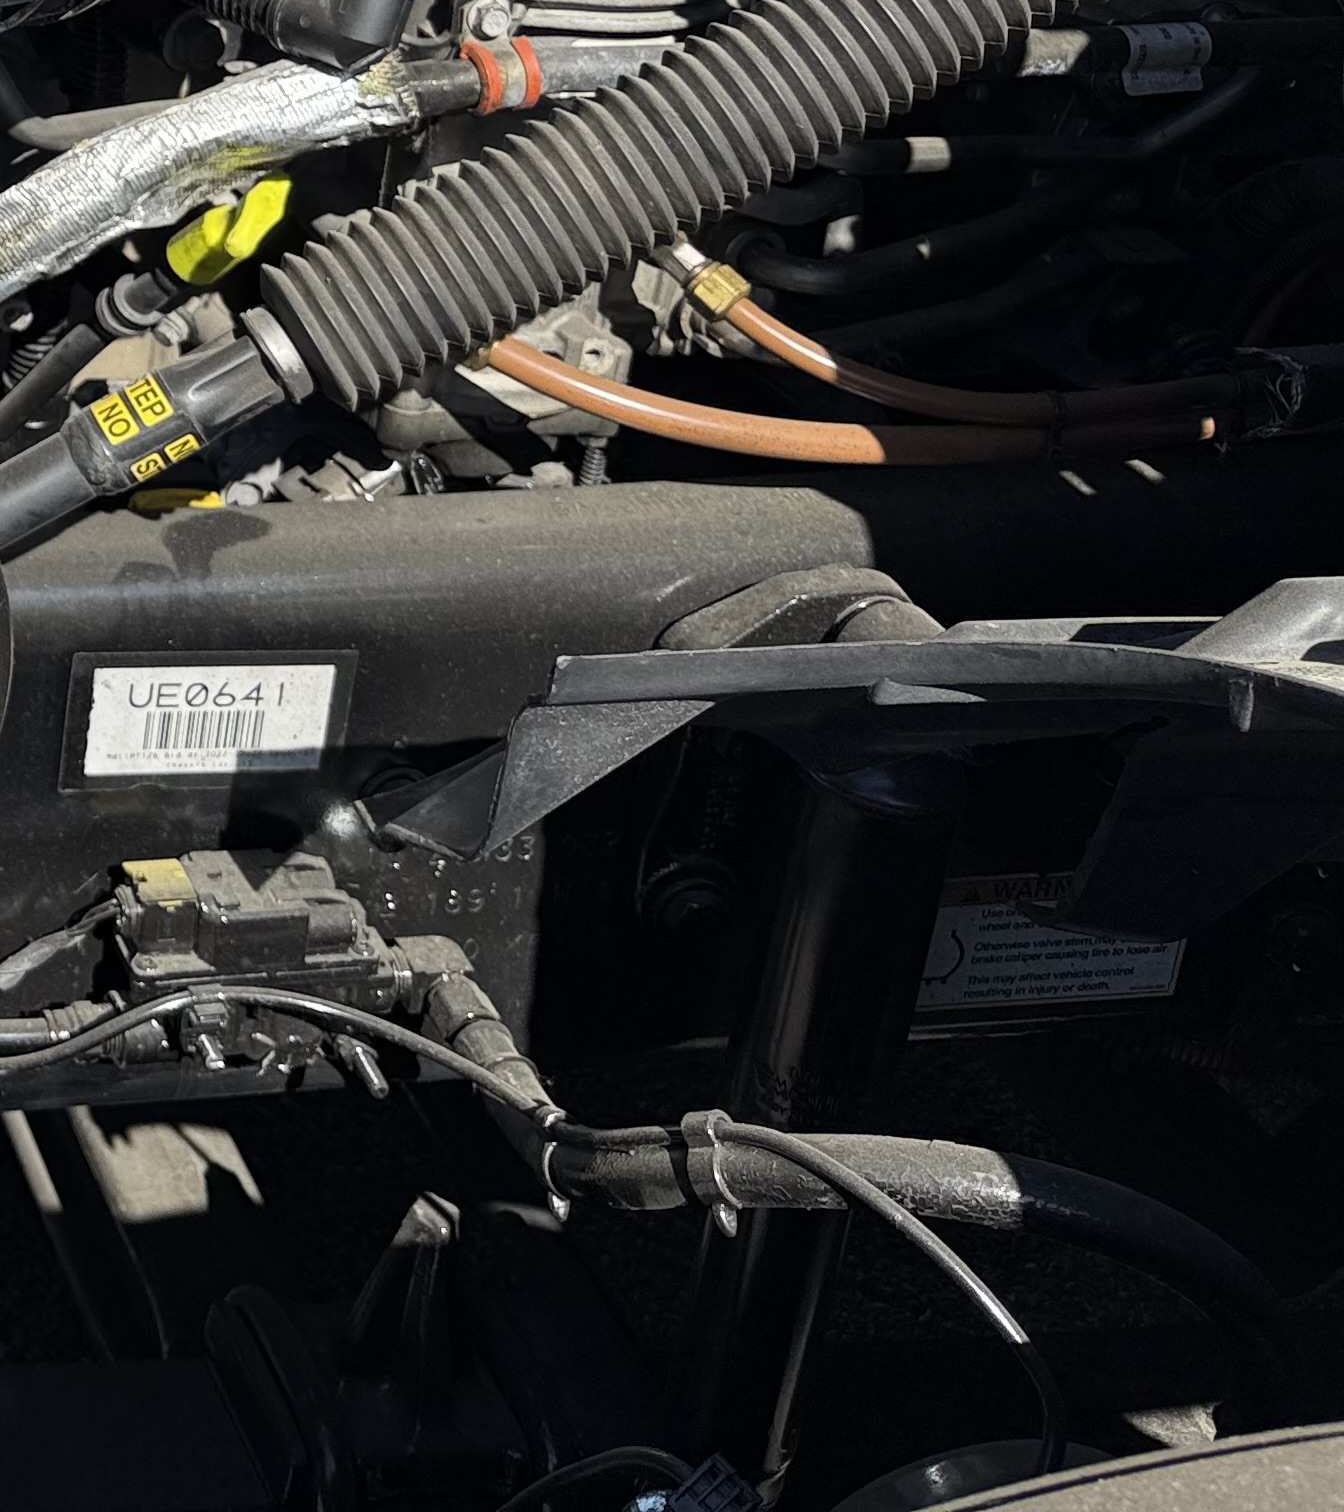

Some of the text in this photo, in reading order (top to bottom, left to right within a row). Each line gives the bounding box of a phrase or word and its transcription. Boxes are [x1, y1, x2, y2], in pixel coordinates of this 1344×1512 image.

[98, 402, 131, 437] NO
[128, 681, 285, 708] UE0641
[994, 879, 1073, 898] WARN
[981, 909, 1003, 919] Use
[978, 920, 1035, 932] wheel and
[971, 944, 1169, 965] brake caliper causing tire to lose air.
[974, 941, 1031, 952] Otherwise
[1033, 940, 1061, 950] valve
[967, 967, 1134, 987] This may affect vehicle control
[963, 981, 1110, 1000] resulting in injury or death.
